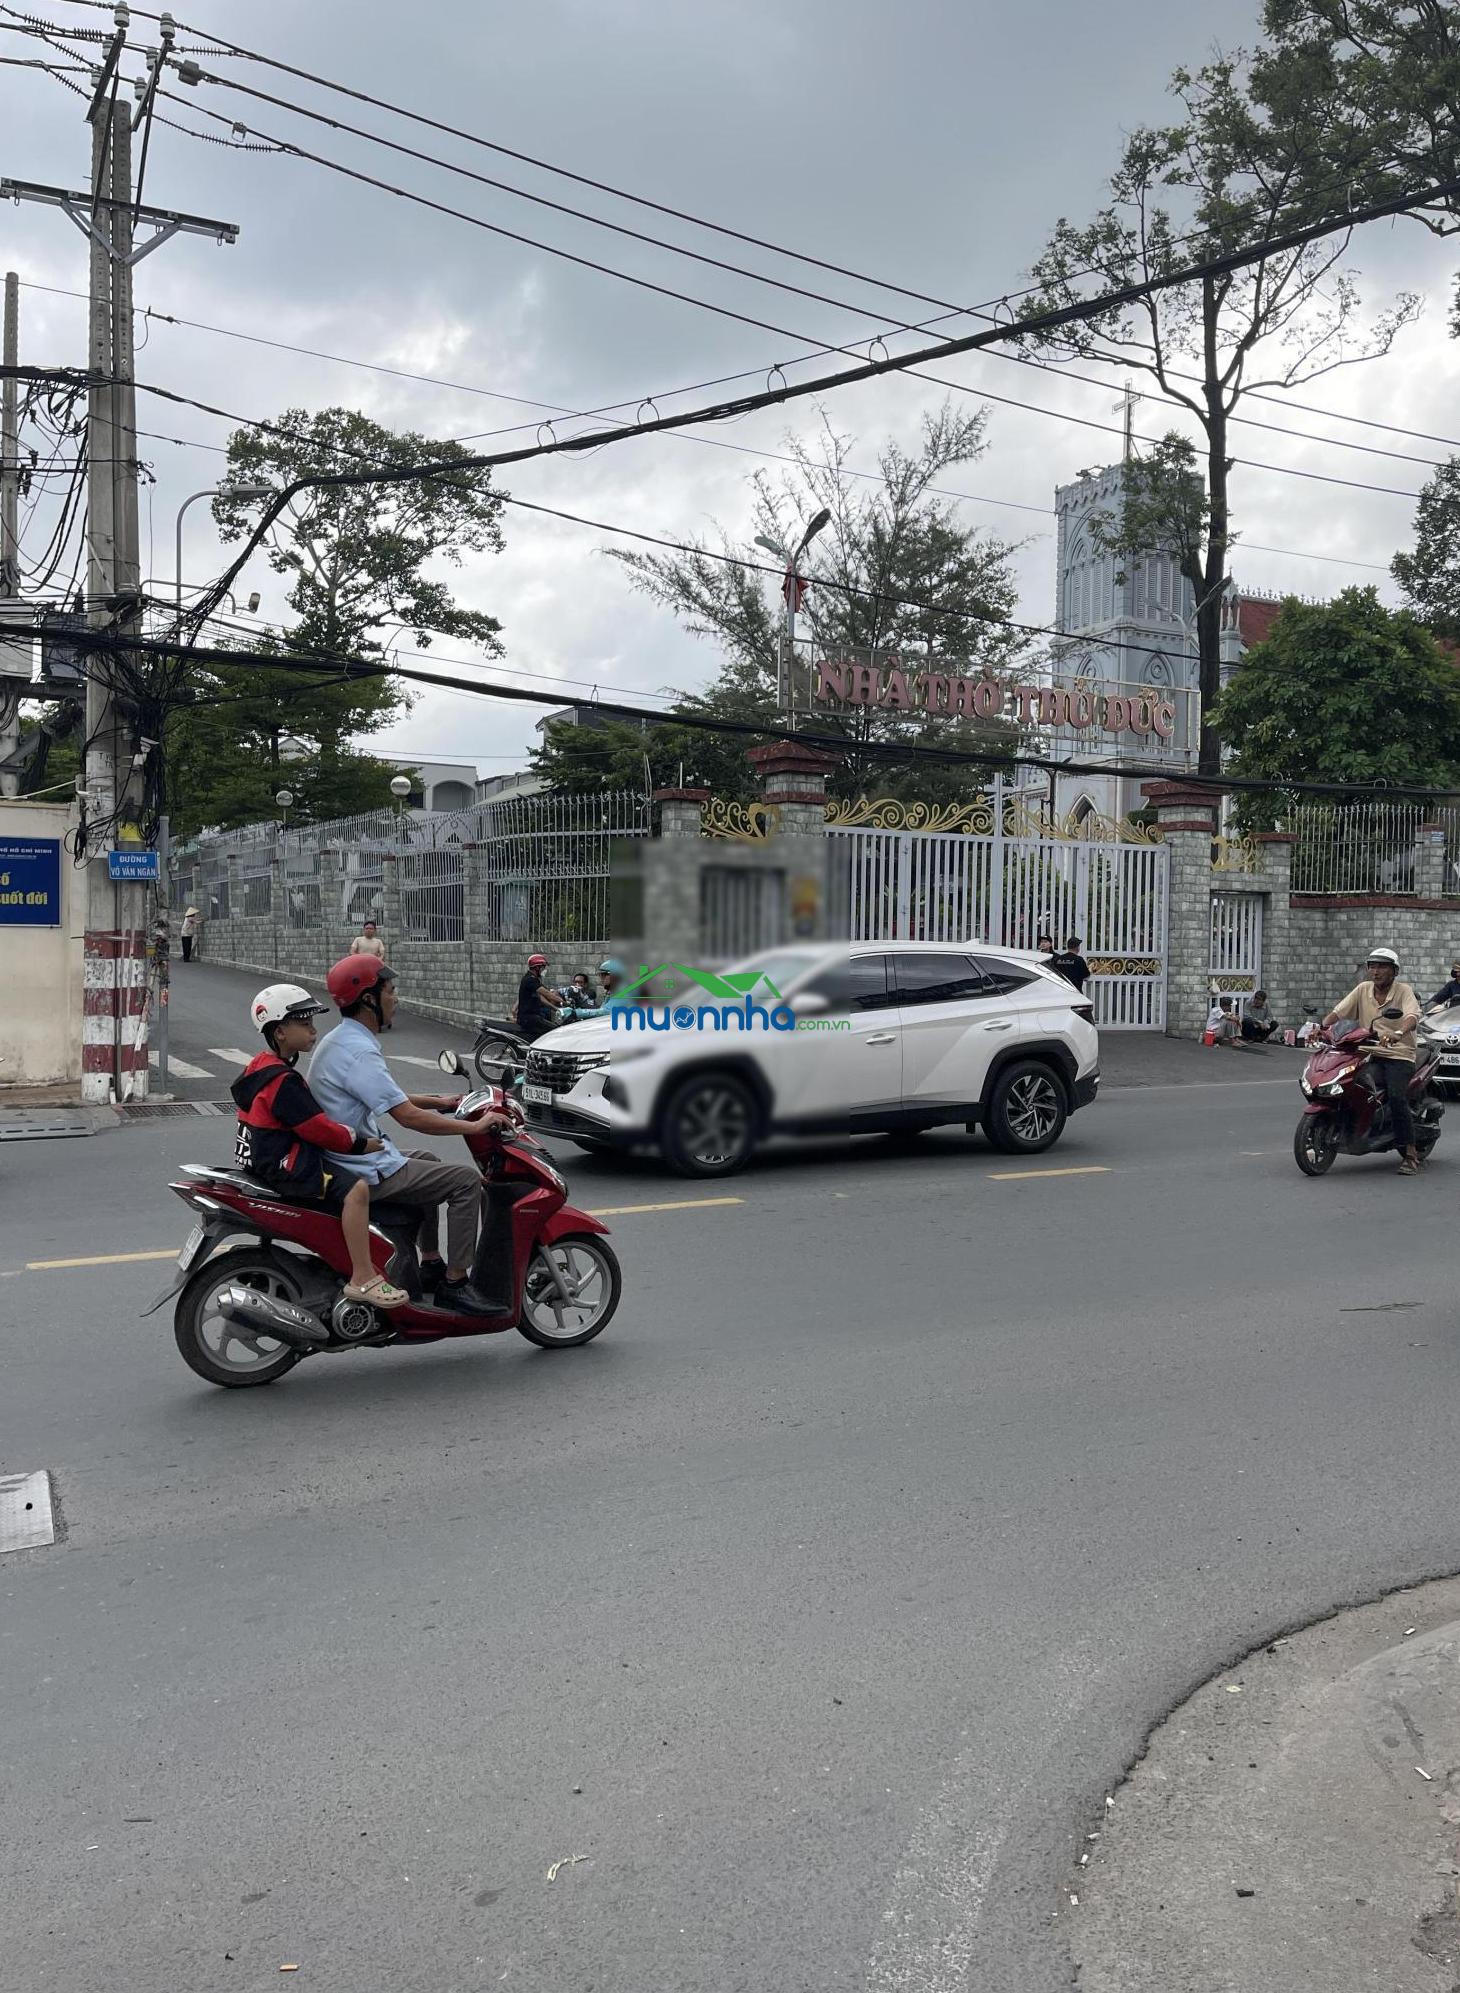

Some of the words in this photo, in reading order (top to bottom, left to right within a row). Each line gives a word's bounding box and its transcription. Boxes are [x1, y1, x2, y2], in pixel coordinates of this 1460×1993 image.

[814, 656, 911, 710] NHÀ
[918, 666, 1003, 719] THỜ
[1014, 678, 1095, 729] THỦ
[1103, 688, 1177, 738] ĐỨC
[119, 855, 148, 863] ĐƯỜNG
[0, 871, 11, 886] ố
[121, 866, 136, 876] VĂN
[0, 890, 24, 905] uốt
[26, 891, 48, 905] đời
